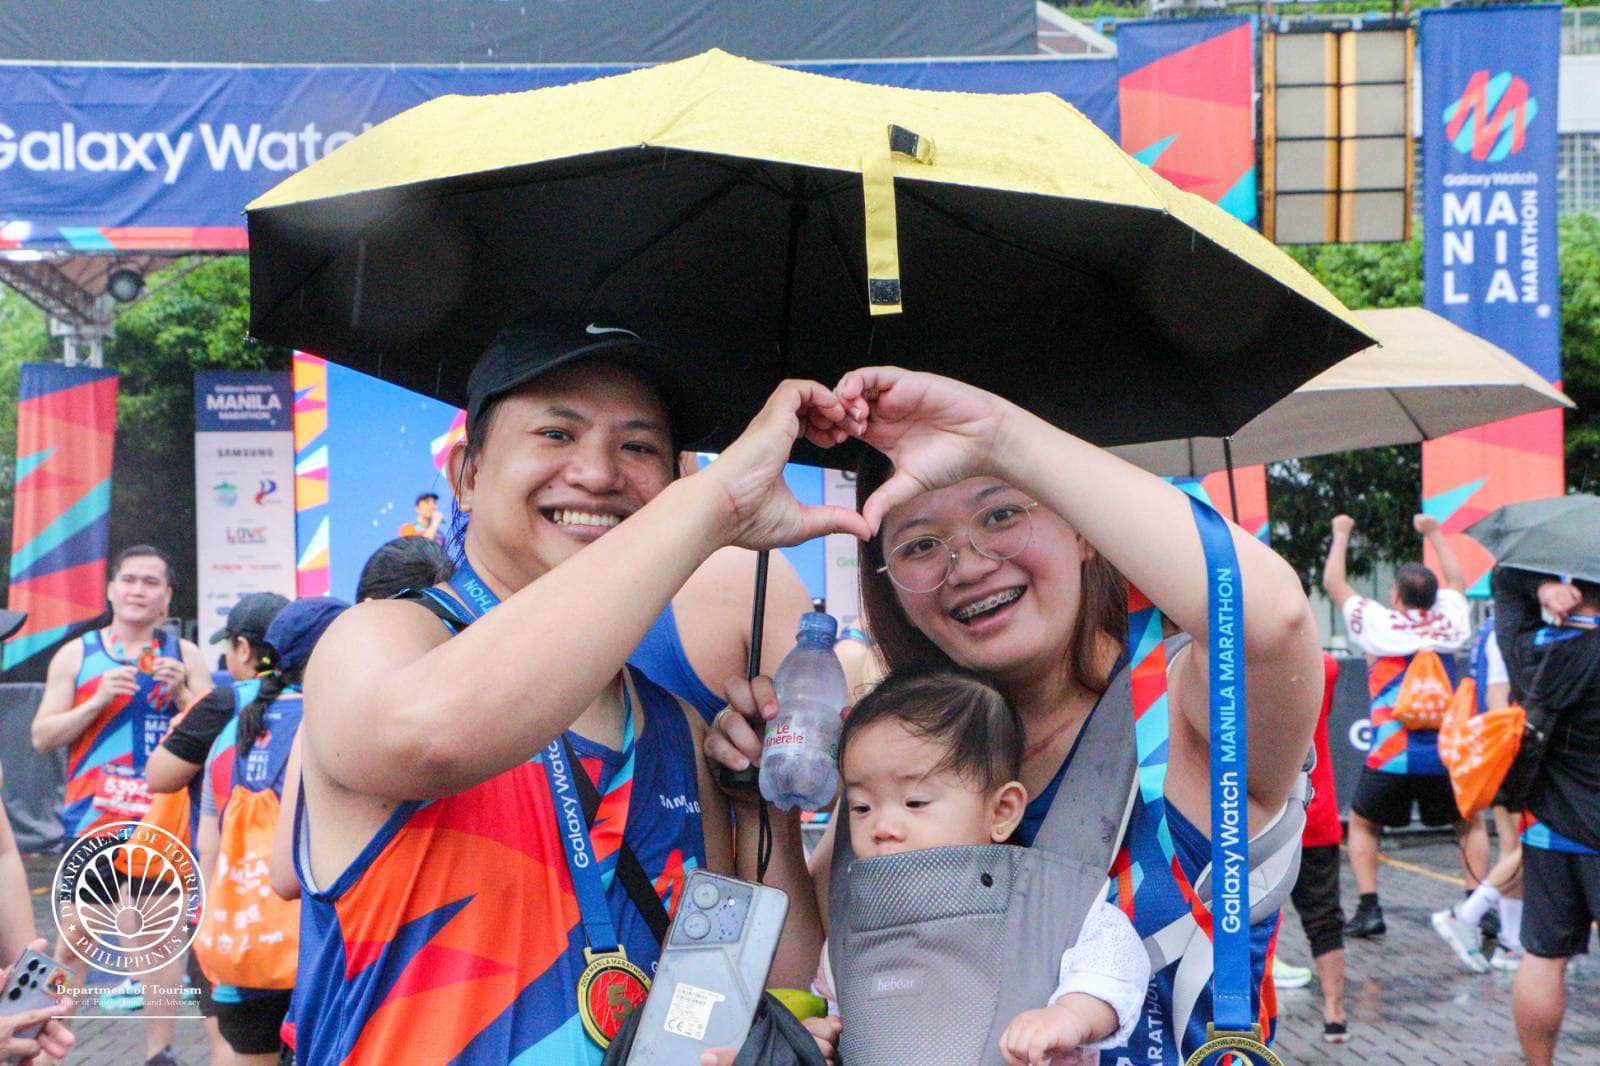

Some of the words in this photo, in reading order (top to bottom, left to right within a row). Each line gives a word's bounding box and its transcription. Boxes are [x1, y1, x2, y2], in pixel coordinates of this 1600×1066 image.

[199, 121, 373, 172] Watc
[1443, 173, 1490, 188] Galaxy
[1520, 190, 1539, 303] MARATHON
[205, 393, 282, 411] MANILA
[217, 448, 274, 457] SAMSUNG
[1216, 567, 1235, 682] MARATHON
[762, 732, 804, 748] inerale
[776, 722, 790, 735] Le
[1219, 686, 1237, 763] MANILA
[547, 740, 570, 794] Watc
[561, 795, 589, 869] Galaxy
[1220, 771, 1239, 849] Watch
[1222, 850, 1245, 933] Galaxy
